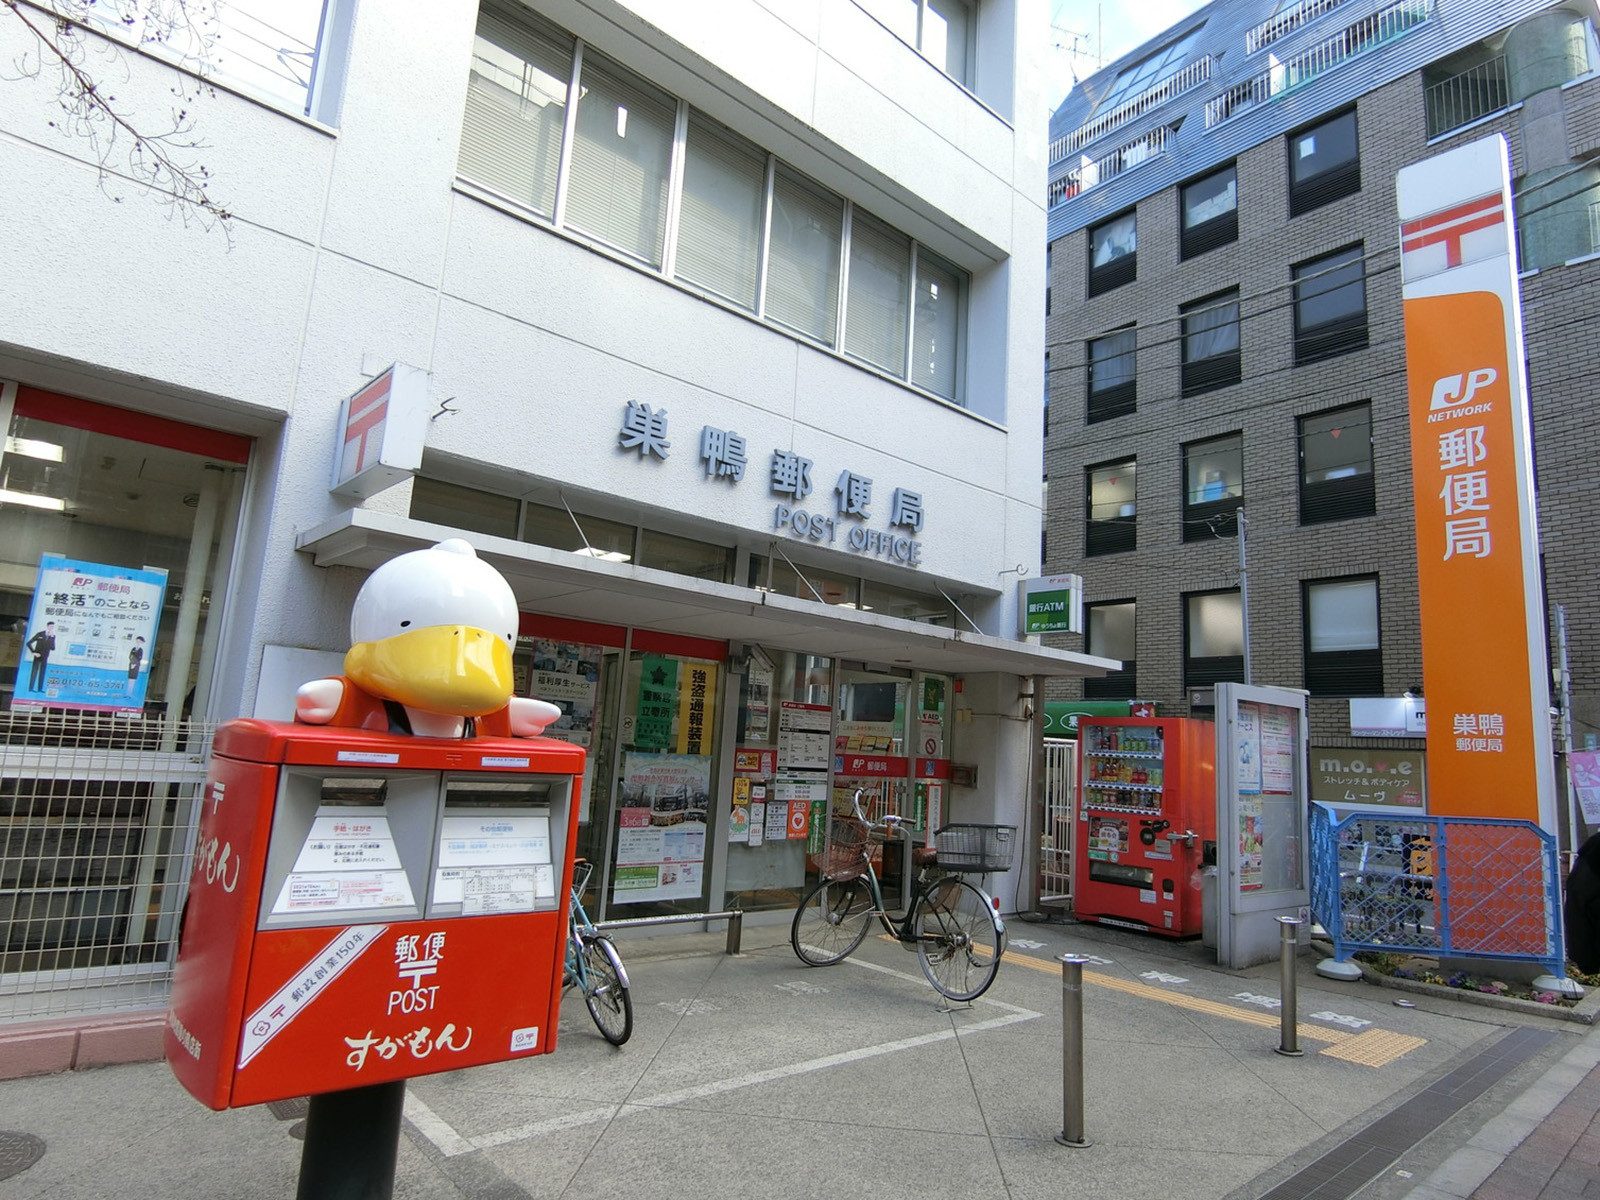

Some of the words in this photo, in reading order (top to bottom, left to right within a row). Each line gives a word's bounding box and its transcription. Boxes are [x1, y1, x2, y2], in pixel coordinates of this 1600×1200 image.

[1427, 402, 1493, 424] NETWORK
[619, 400, 925, 533] 巣鴨郵便局
[1438, 425, 1492, 562] 郵便局
[776, 504, 839, 542] POST
[850, 527, 922, 566] OFFICE
[97, 582, 131, 595] 郵便局
[1029, 602, 1065, 613] 銀行ATM
[1453, 713, 1504, 736] 巣鴨
[1456, 737, 1503, 752] 郵便局
[1344, 789, 1386, 802] ムーヴ
[394, 931, 446, 964] 郵便
[291, 931, 365, 1003] 郵政創業150年
[387, 986, 440, 1016] POST
[344, 1023, 473, 1072] すがもん
